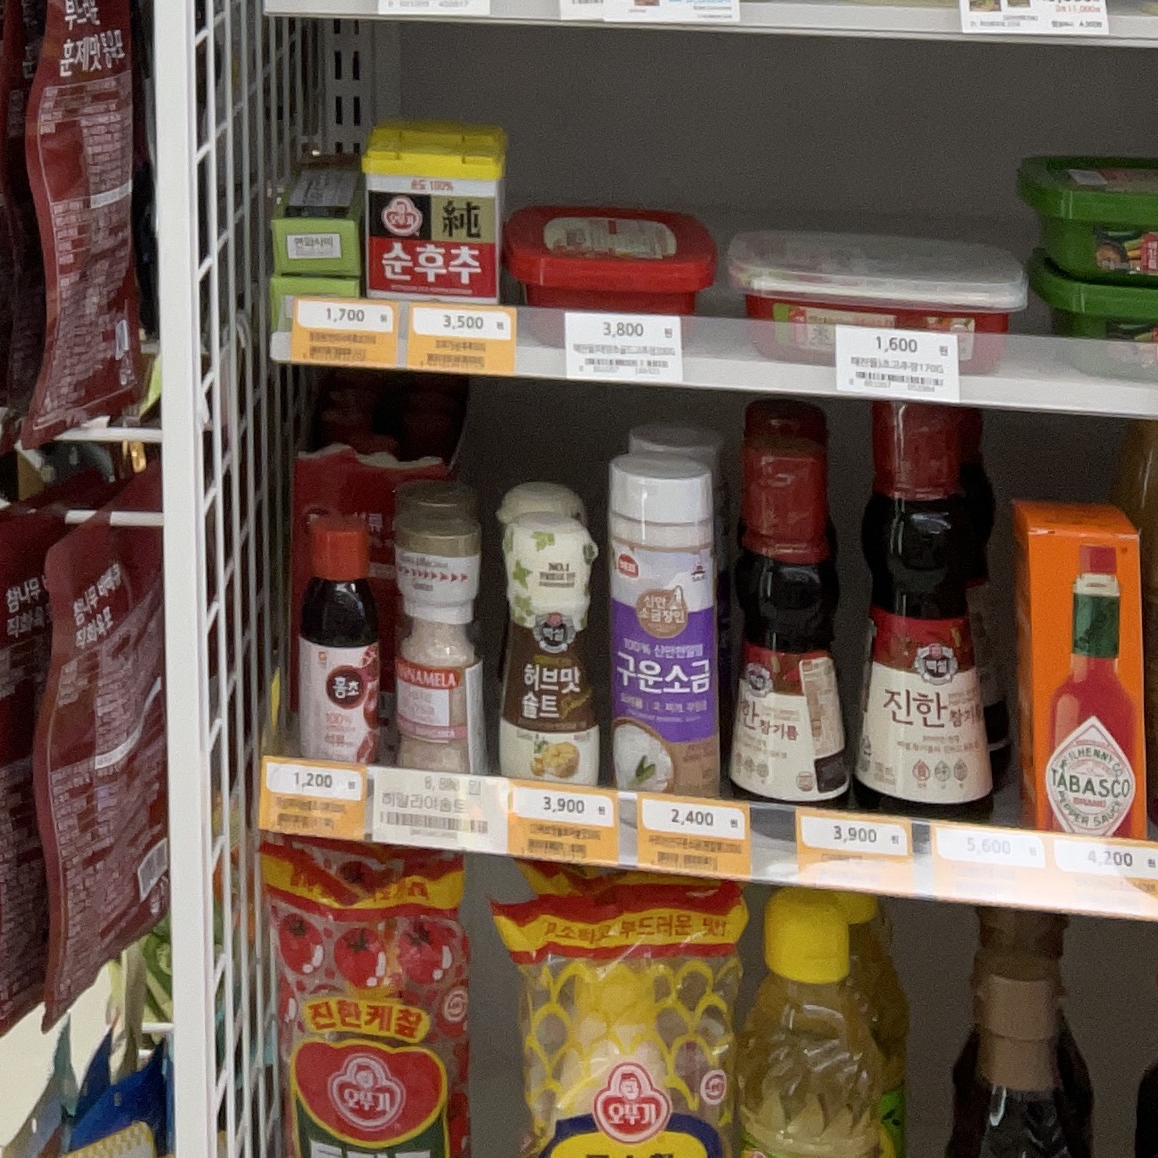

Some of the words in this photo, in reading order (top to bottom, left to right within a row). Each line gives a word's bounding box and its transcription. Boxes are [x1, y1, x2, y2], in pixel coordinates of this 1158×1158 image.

[442, 200, 481, 239] 純
[381, 241, 482, 284] 순후추
[326, 307, 365, 323] 1,700
[443, 315, 484, 331] 3,500
[603, 322, 644, 338] 3,800
[876, 336, 918, 354] 1,600
[523, 663, 582, 694] 허브맛
[617, 651, 710, 694] 구운소금
[521, 693, 560, 720] 솔트
[883, 688, 949, 729] 진한
[292, 771, 333, 789] 1,200
[1051, 767, 1130, 798] TABASCO
[542, 796, 586, 815] 3,900
[671, 808, 714, 828] 2,400
[833, 825, 879, 843] 3,900
[1087, 850, 1134, 867] 4,200
[621, 914, 692, 939] 부드러운
[307, 1001, 423, 1039] 진한케찹
[343, 1088, 391, 1112] 오뚜기
[608, 1103, 657, 1126] 오뚜기
